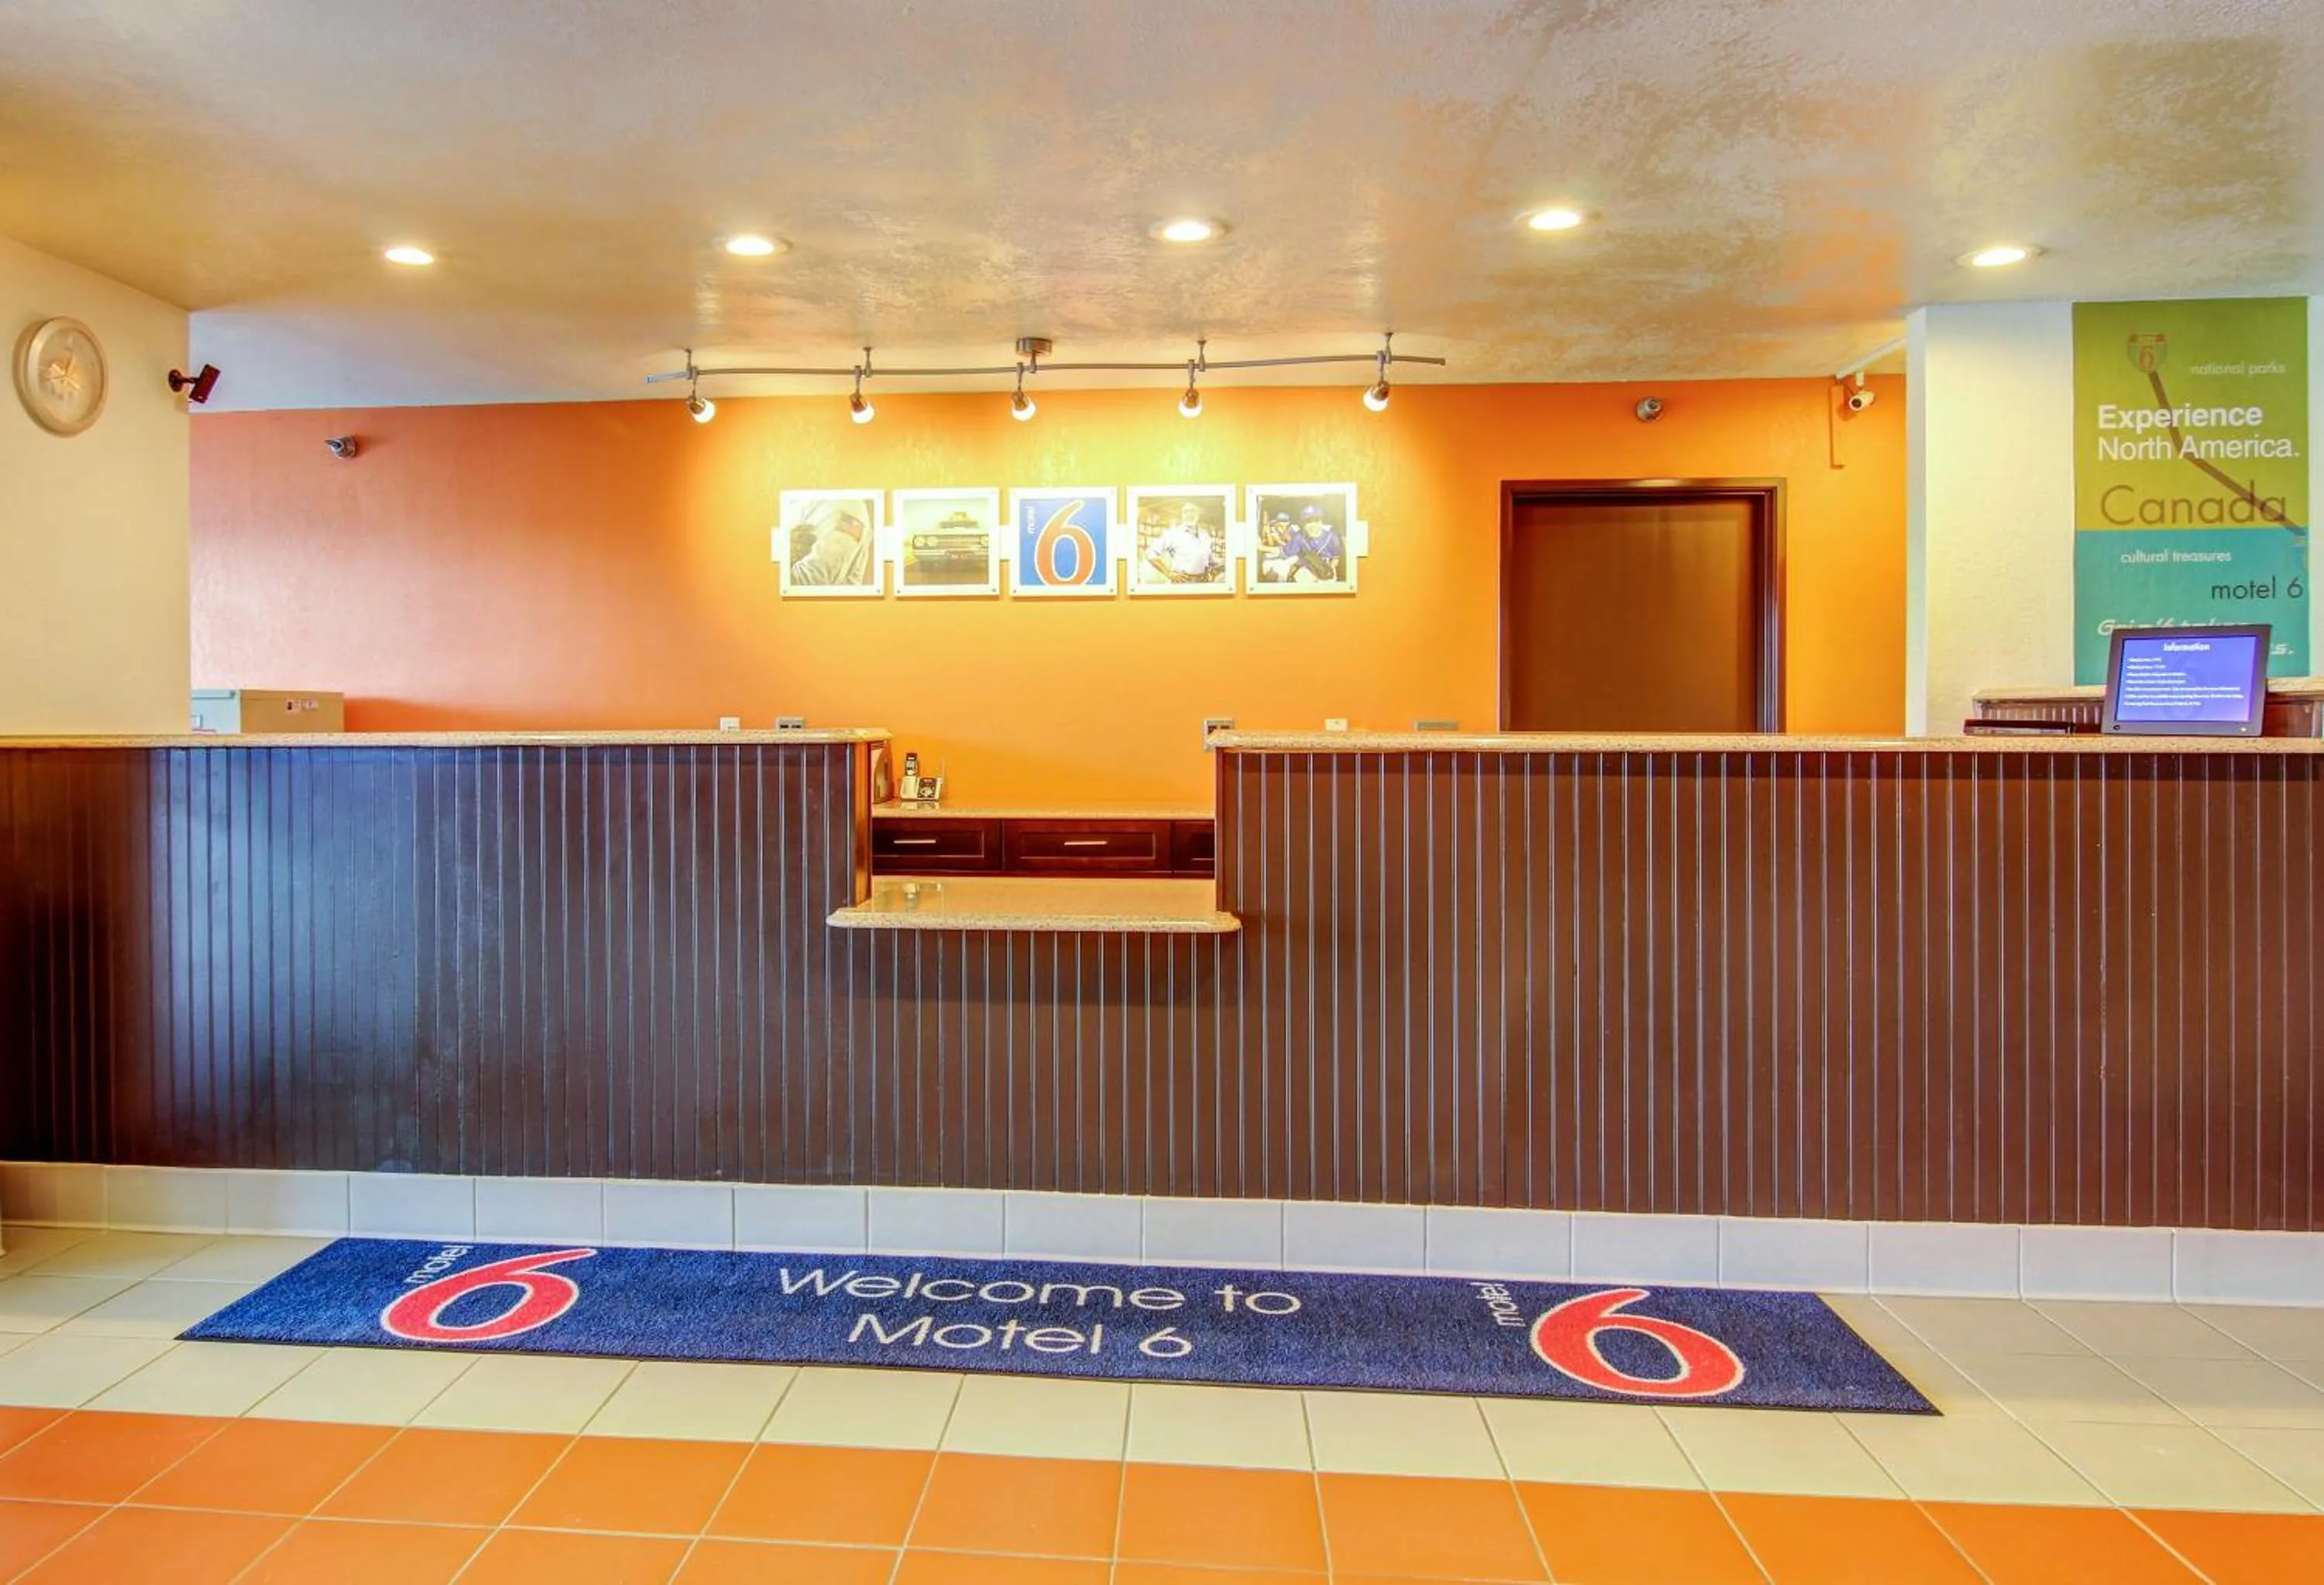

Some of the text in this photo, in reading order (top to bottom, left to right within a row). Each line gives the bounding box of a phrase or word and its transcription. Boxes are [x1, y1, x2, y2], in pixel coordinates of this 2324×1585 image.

[2191, 360, 2286, 377] national parks
[2098, 404, 2263, 434] Experience
[2098, 434, 2300, 461] North America.
[2100, 479, 2287, 525] Canada
[1034, 499, 1096, 586] 6
[2120, 549, 2232, 563] cultural treasures
[2212, 575, 2304, 600] motel 6
[380, 1245, 598, 1343] motel 6
[779, 1268, 1301, 1315] Welcome to
[848, 1314, 1193, 1358] Motel 6
[1470, 1282, 1745, 1397] motel 6
